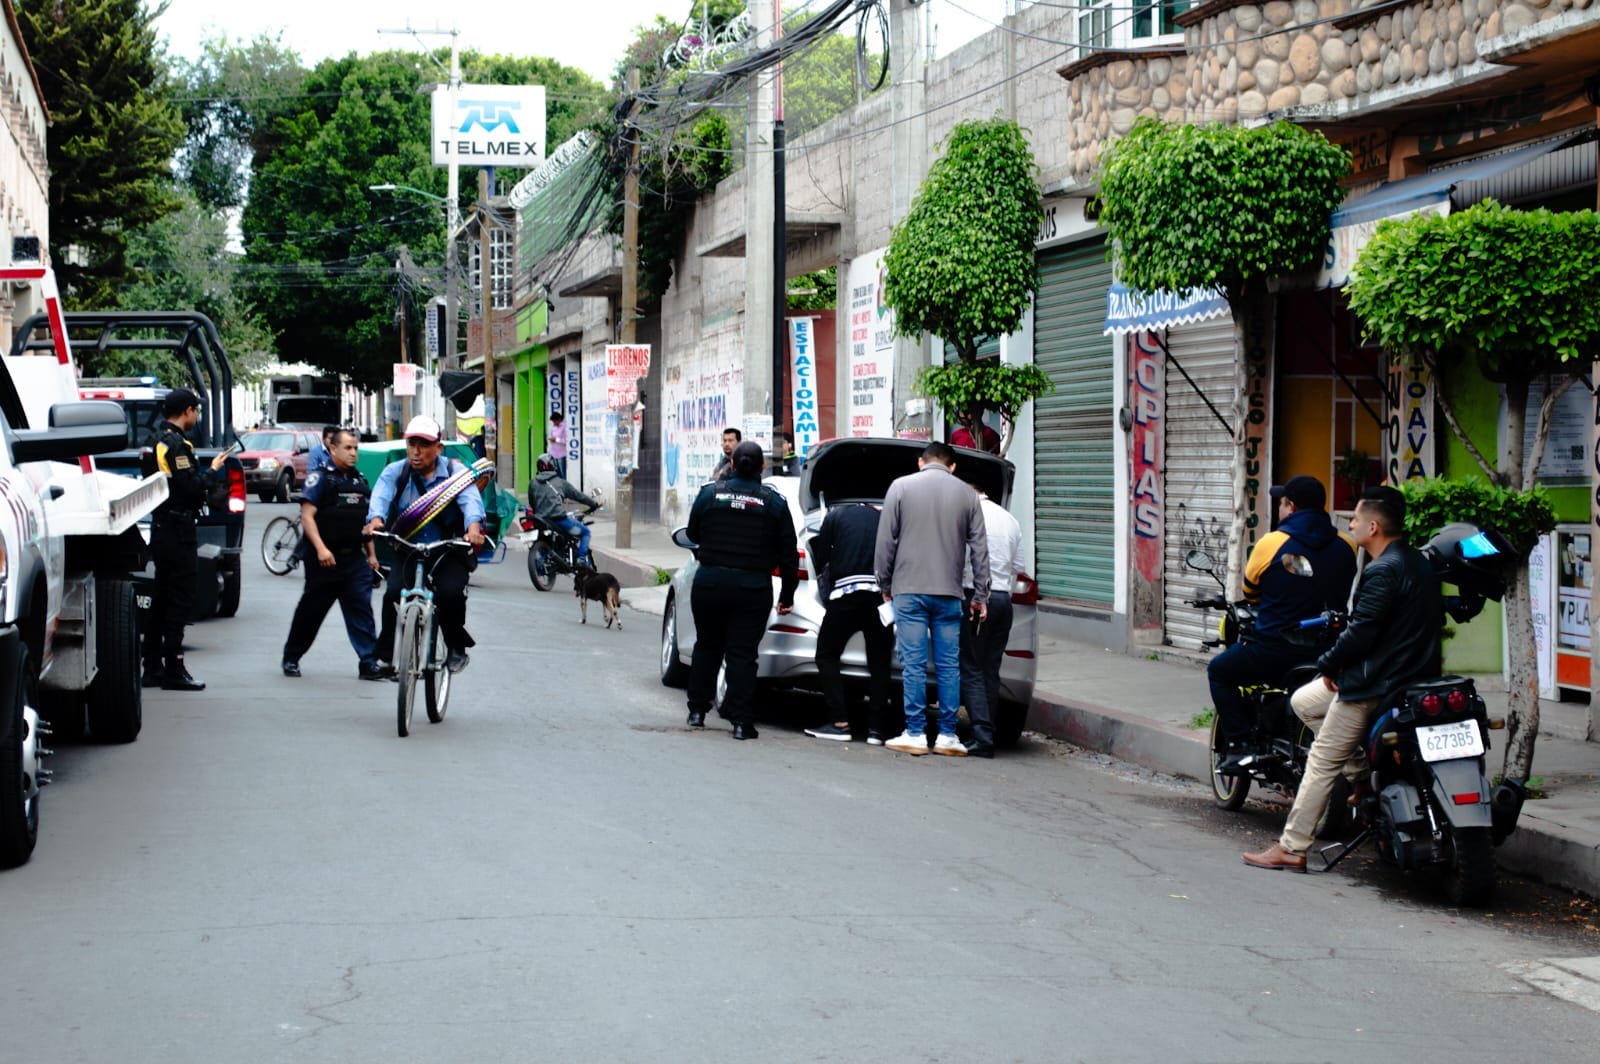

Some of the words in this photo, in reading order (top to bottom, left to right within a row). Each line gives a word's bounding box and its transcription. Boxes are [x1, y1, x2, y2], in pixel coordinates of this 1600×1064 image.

[440, 140, 537, 156] TELMEX
[608, 348, 649, 366] TERRENOS
[568, 371, 580, 460] ESCRITOS
[698, 397, 706, 430] DE
[708, 393, 727, 429] ROPA
[1135, 330, 1163, 540] COPIAS
